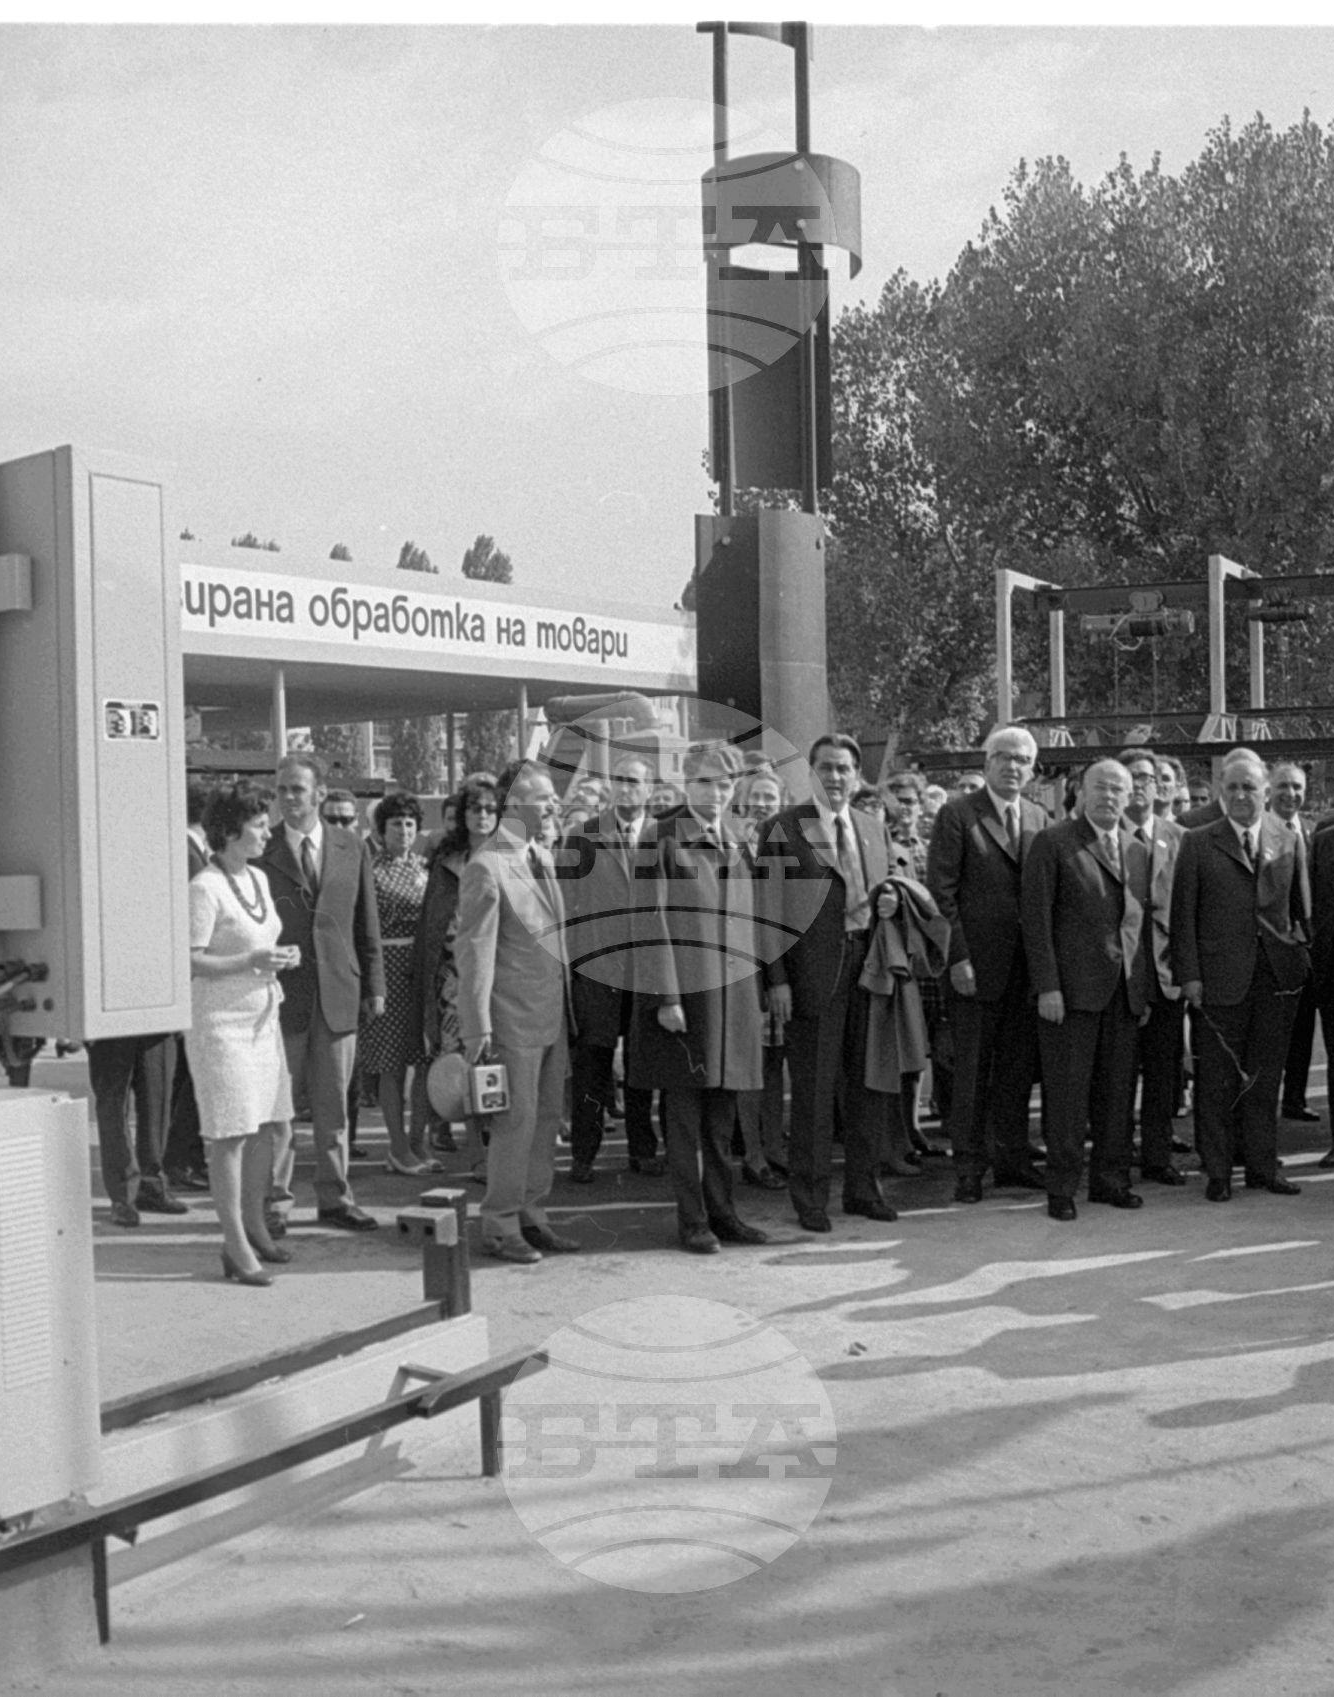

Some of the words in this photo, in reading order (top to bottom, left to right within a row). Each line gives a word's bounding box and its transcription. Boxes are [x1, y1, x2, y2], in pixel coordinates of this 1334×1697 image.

[180, 580, 295, 628] ирана
[308, 587, 485, 641] обработка
[496, 616, 526, 647] на
[536, 617, 628, 664] товари
